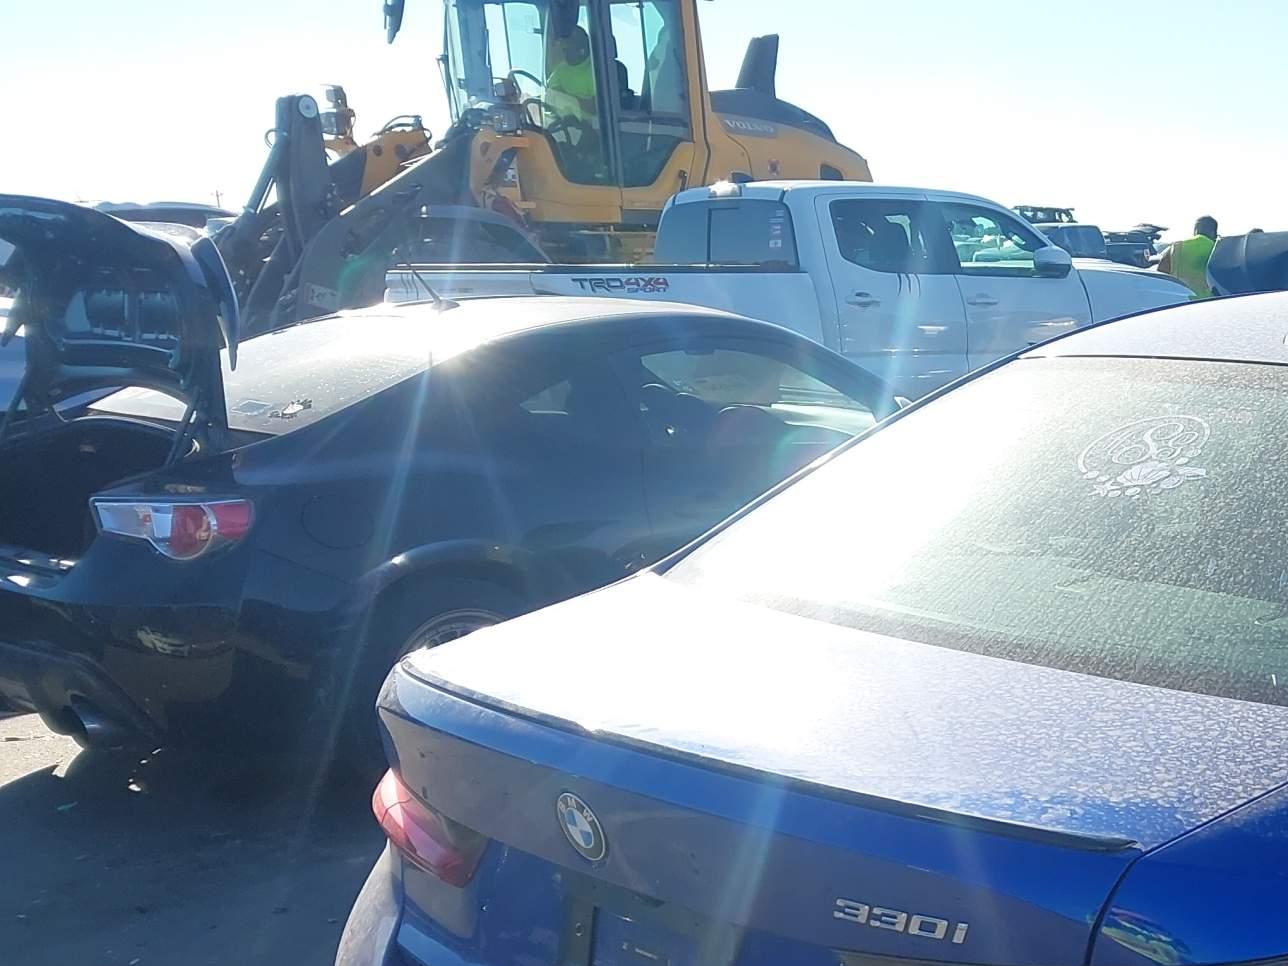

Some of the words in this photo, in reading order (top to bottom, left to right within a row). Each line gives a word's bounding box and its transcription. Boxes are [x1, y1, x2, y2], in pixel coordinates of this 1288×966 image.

[723, 119, 775, 134] VOLVO
[558, 796, 593, 823] BMW
[833, 898, 968, 944] 330i
